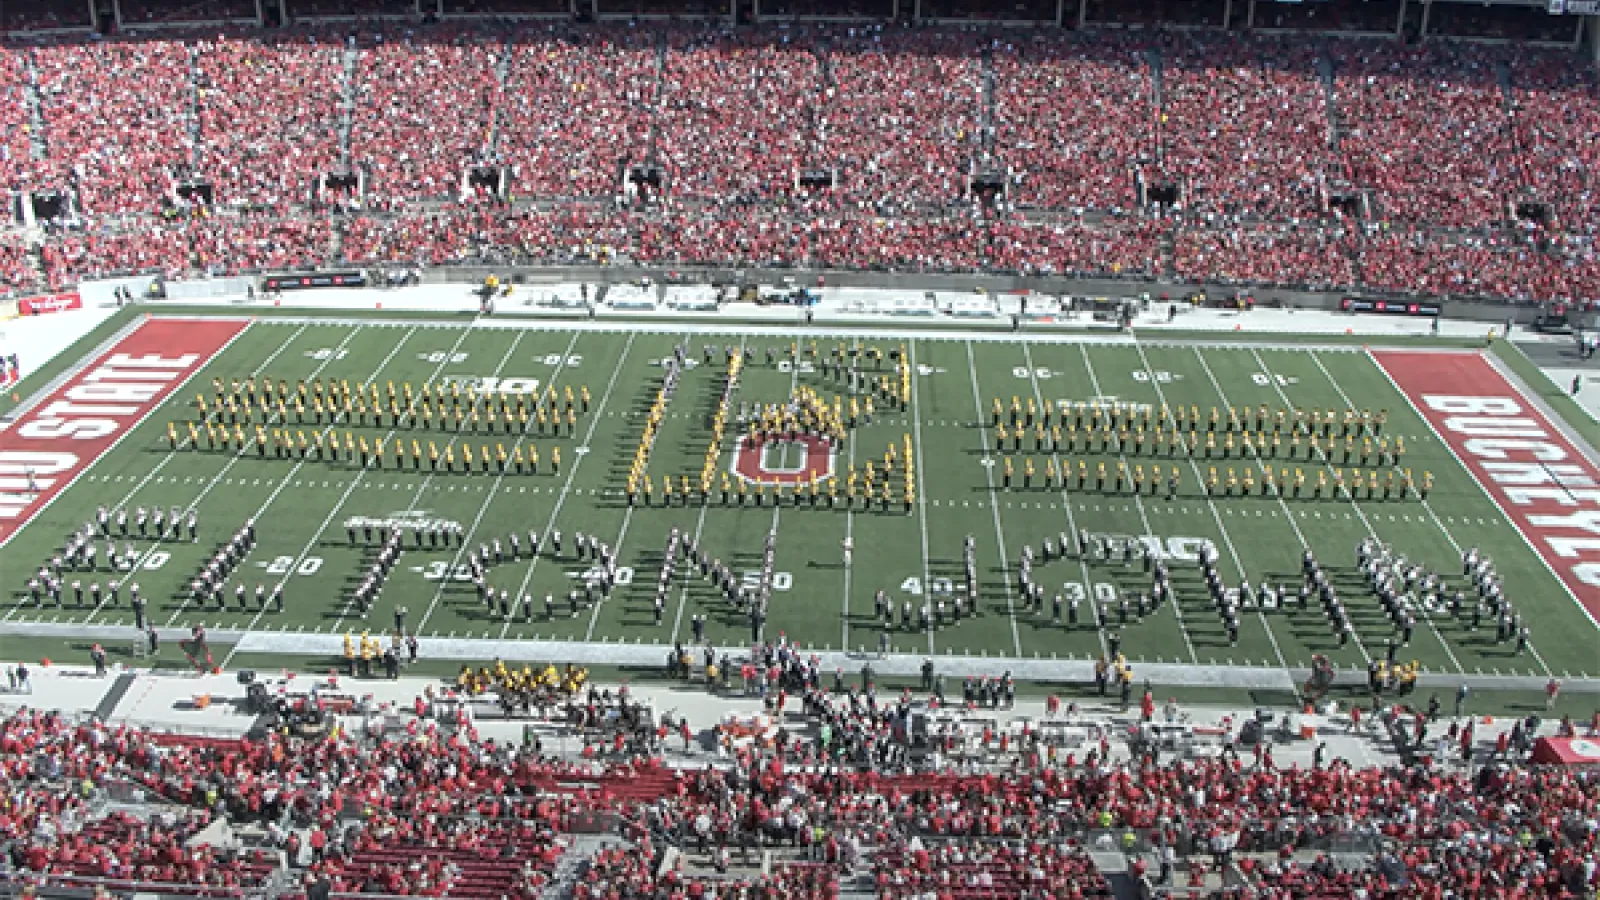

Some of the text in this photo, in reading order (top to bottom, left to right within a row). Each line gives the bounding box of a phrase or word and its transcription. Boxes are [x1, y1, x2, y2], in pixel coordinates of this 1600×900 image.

[16, 353, 200, 440] STATE
[1421, 393, 1600, 588] BUCKEY
[266, 556, 323, 576] 20
[1063, 582, 1117, 601] 30
